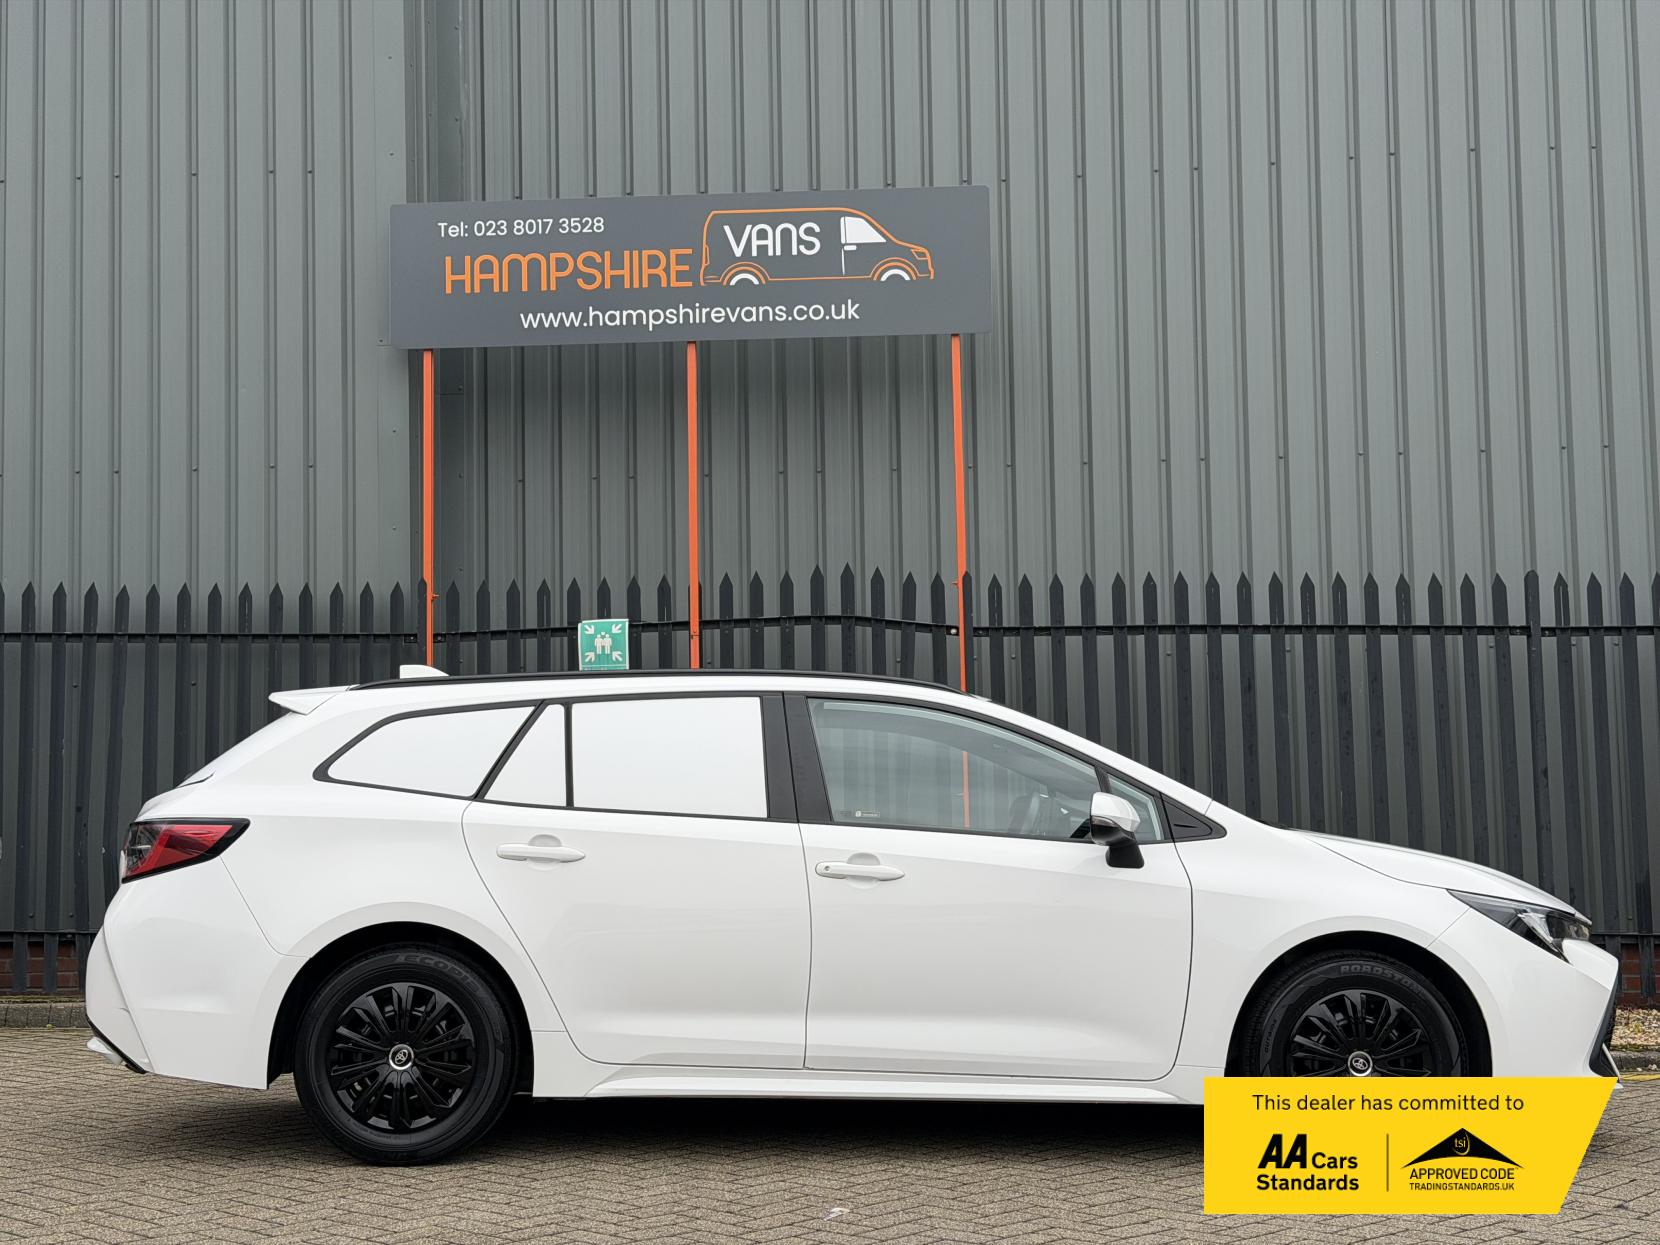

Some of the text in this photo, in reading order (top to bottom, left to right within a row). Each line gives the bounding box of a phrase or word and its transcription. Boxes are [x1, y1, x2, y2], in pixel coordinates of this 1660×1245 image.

[437, 216, 605, 238] Tel: 023 8017 3528
[722, 221, 821, 258] VANS
[444, 247, 694, 295] HAMPSHIRE
[519, 298, 861, 332] www.hampshirevans.co.uk
